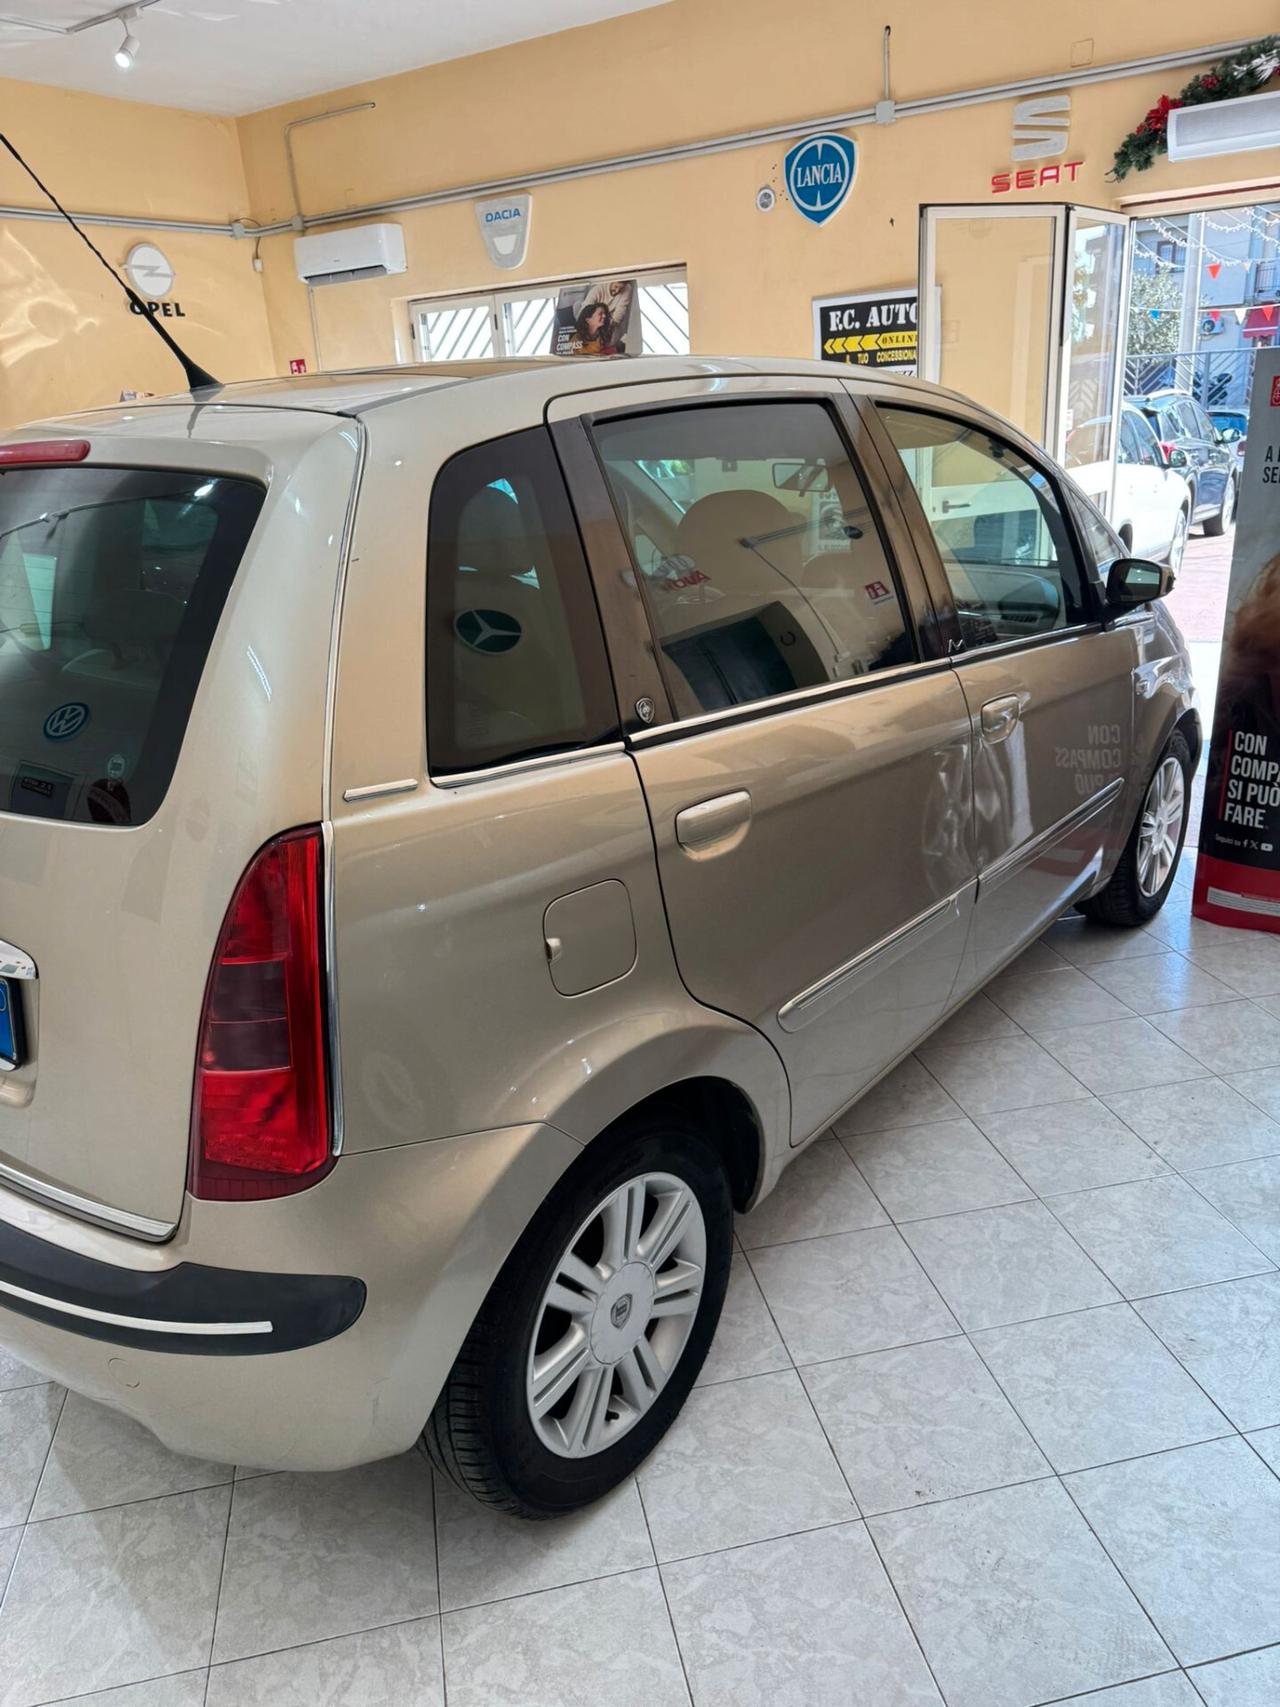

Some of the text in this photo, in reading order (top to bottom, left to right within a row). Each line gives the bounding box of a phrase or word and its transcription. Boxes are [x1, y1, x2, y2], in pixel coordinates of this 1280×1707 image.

[797, 162, 842, 188] LANCIA
[991, 161, 1084, 194] SEAT
[485, 207, 521, 223] DACIA
[130, 301, 186, 317] OPEL
[1262, 466, 1280, 484] SE
[1234, 730, 1268, 757] CON
[1227, 778, 1280, 807] SI PUÒ
